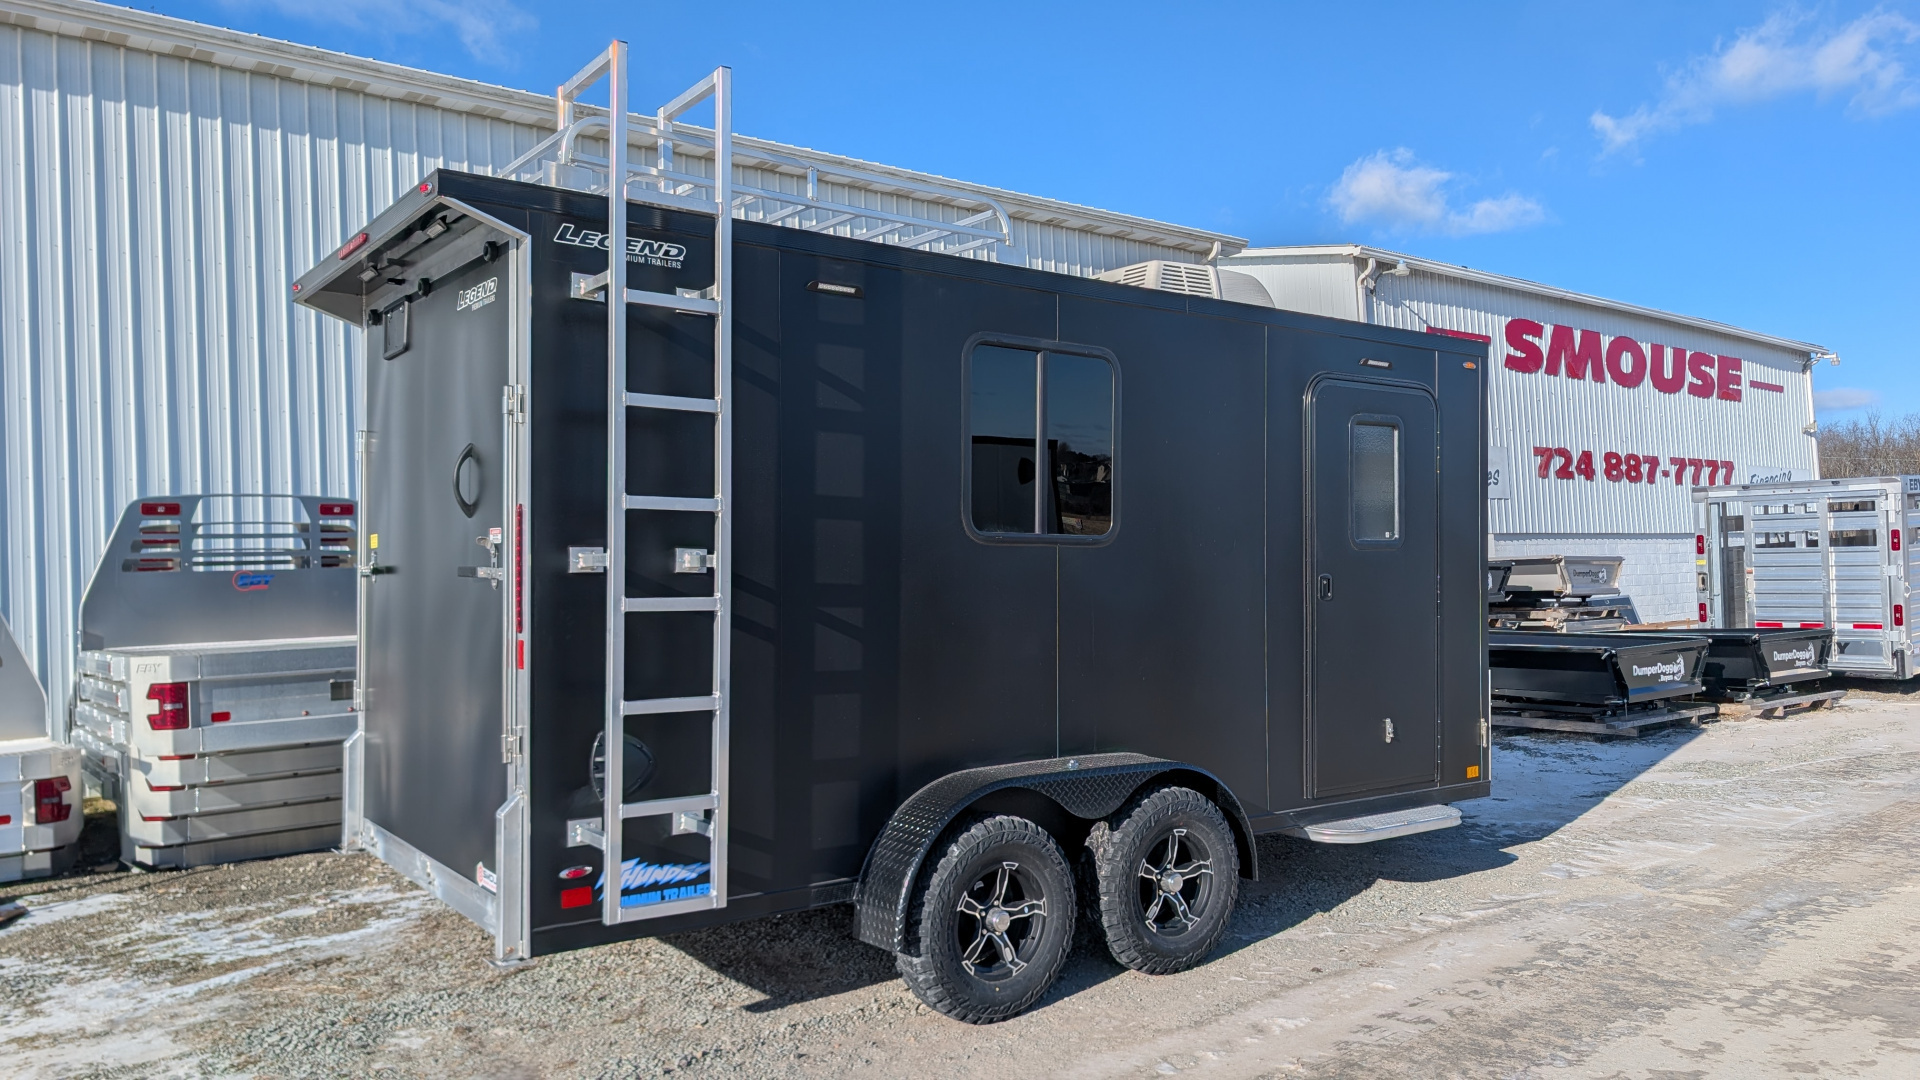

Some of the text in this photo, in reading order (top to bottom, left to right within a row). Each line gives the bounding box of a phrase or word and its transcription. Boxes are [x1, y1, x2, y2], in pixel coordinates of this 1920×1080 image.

[625, 254, 682, 269] MIUM TRAILERS
[457, 276, 498, 311] LEGEND
[1504, 318, 1742, 403] SMOUSE
[1533, 446, 1595, 481] 724
[1603, 451, 1735, 486] 887-7777
[1749, 468, 1792, 484] Financing
[1773, 649, 1806, 662] DumperDogg
[136, 662, 163, 674] EBY
[1632, 662, 1673, 677] DumperDogg
[663, 883, 711, 901] TRAILER
